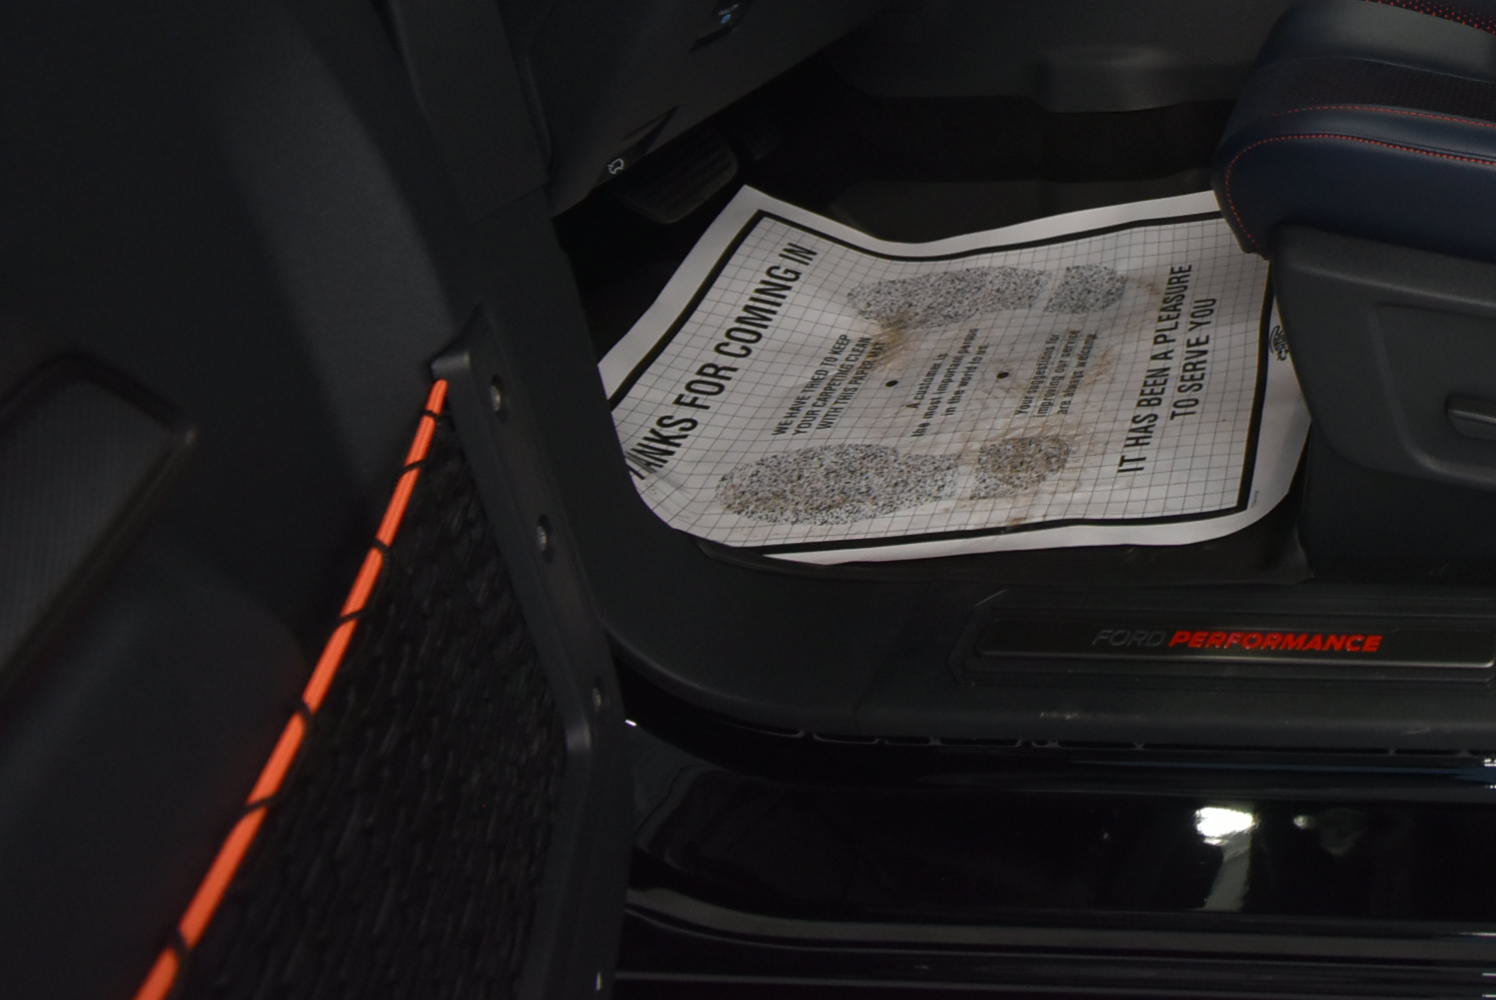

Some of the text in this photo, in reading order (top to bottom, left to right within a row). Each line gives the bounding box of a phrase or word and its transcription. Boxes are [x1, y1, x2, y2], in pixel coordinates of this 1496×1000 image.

[673, 363, 739, 410] FOR
[714, 265, 802, 359] COMING
[778, 242, 818, 266] IN
[1117, 264, 1192, 474] IT HAS BEEN A PLEASURE
[1170, 298, 1217, 420] TO SERVE YOU
[771, 334, 852, 436] WE HAVE TRIED TO KEEP
[792, 337, 872, 436] YOUR CARPETING CLEAN
[816, 404, 845, 430] WITH
[832, 382, 859, 405] THIS
[1092, 629, 1384, 653] FORD PERFORMANCE
